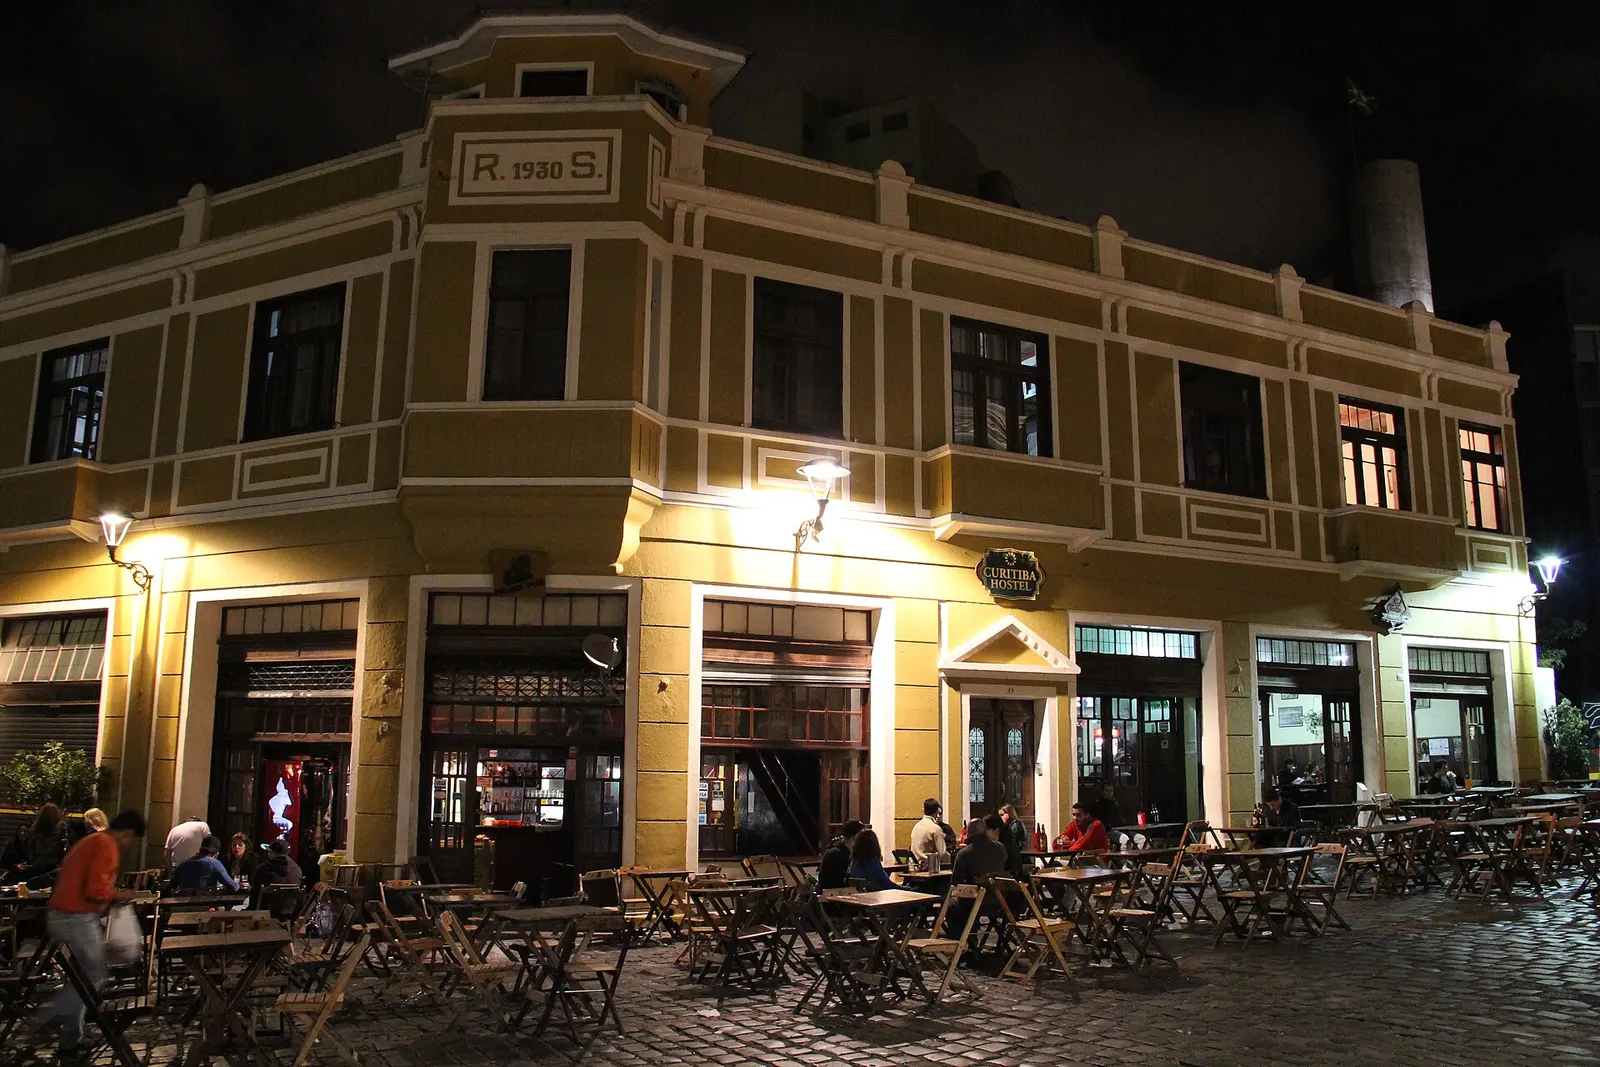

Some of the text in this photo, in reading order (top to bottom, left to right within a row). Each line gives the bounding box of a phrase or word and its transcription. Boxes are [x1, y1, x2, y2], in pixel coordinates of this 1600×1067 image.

[472, 151, 603, 181] R. 1930 S.
[983, 566, 1036, 581] CURITIBA
[990, 579, 1032, 591] HOSTEL
